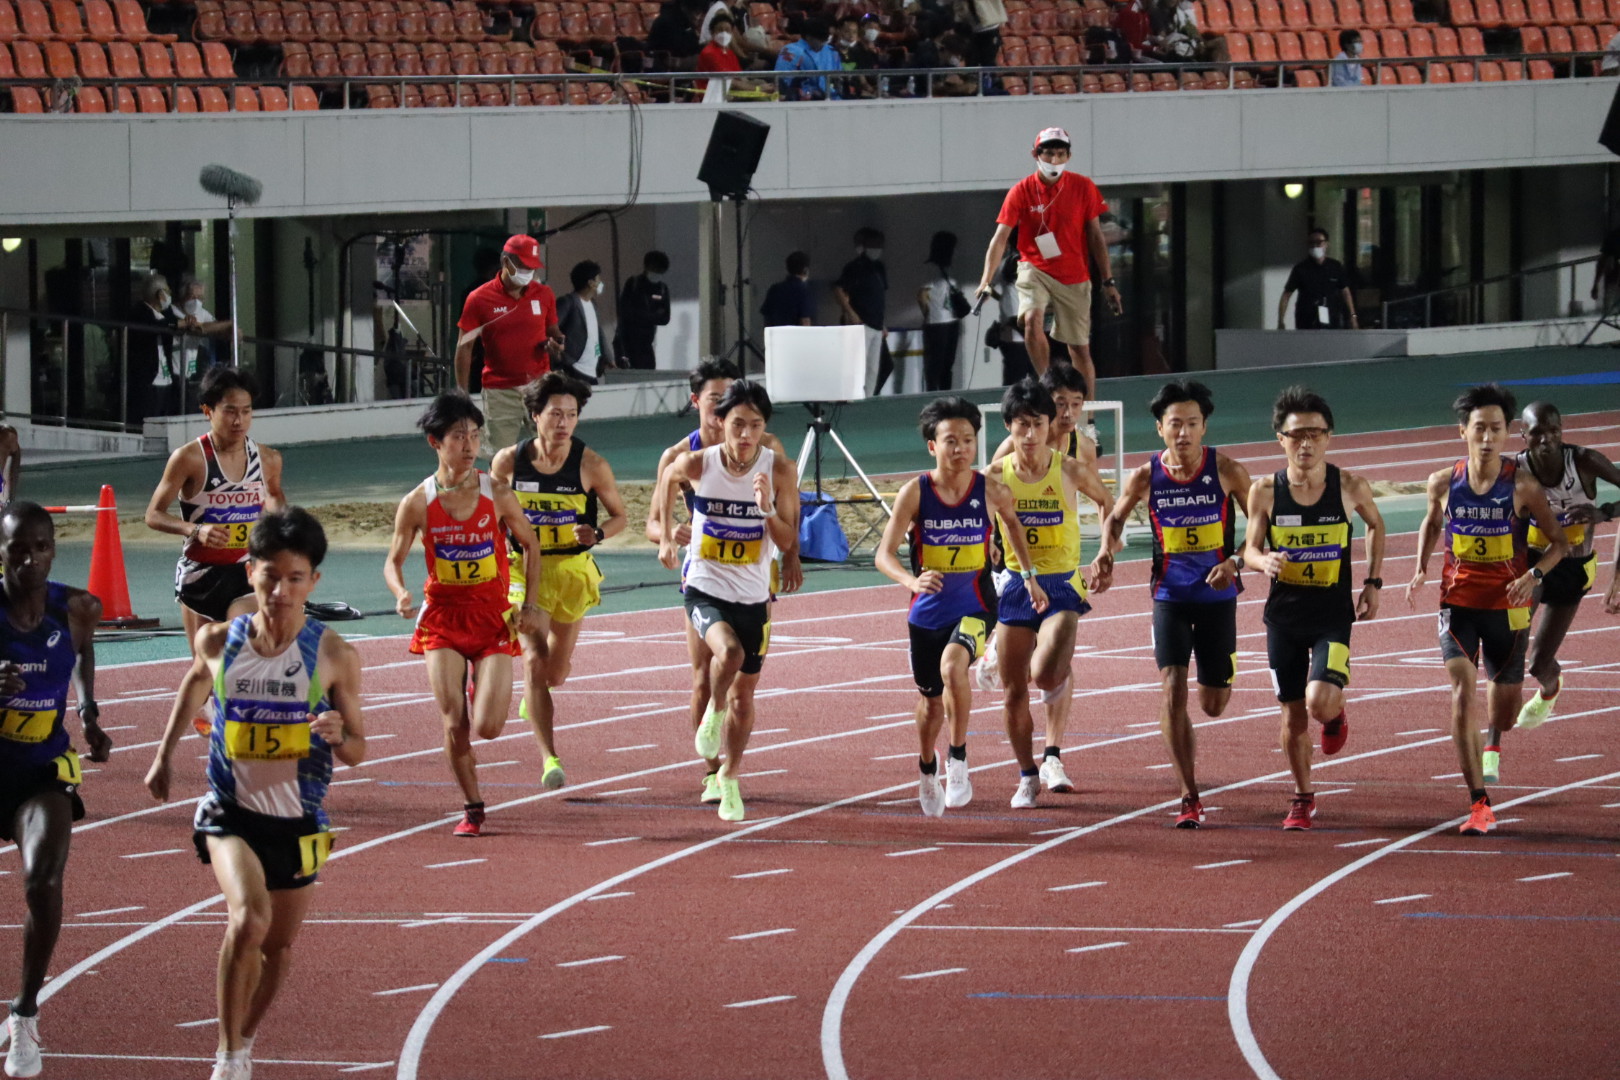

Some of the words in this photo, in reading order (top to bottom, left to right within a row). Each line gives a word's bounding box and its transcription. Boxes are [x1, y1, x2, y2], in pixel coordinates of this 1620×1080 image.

[207, 492, 260, 504] TOYOTA
[528, 499, 564, 510] 九電工
[1018, 499, 1060, 509] 日立物流
[1157, 494, 1217, 508] SUBARU
[1455, 506, 1504, 520] 愛知製鋼
[924, 518, 983, 529] SUBARU
[1026, 527, 1039, 545] 6
[1186, 527, 1199, 546] 5
[1287, 532, 1329, 546] 九電工
[717, 540, 746, 559] 10
[1474, 537, 1487, 556] 3
[948, 545, 961, 567] 7
[451, 561, 481, 580] 12
[1302, 563, 1315, 580] 4
[236, 679, 297, 698] 安川電機
[249, 725, 281, 754] 15
